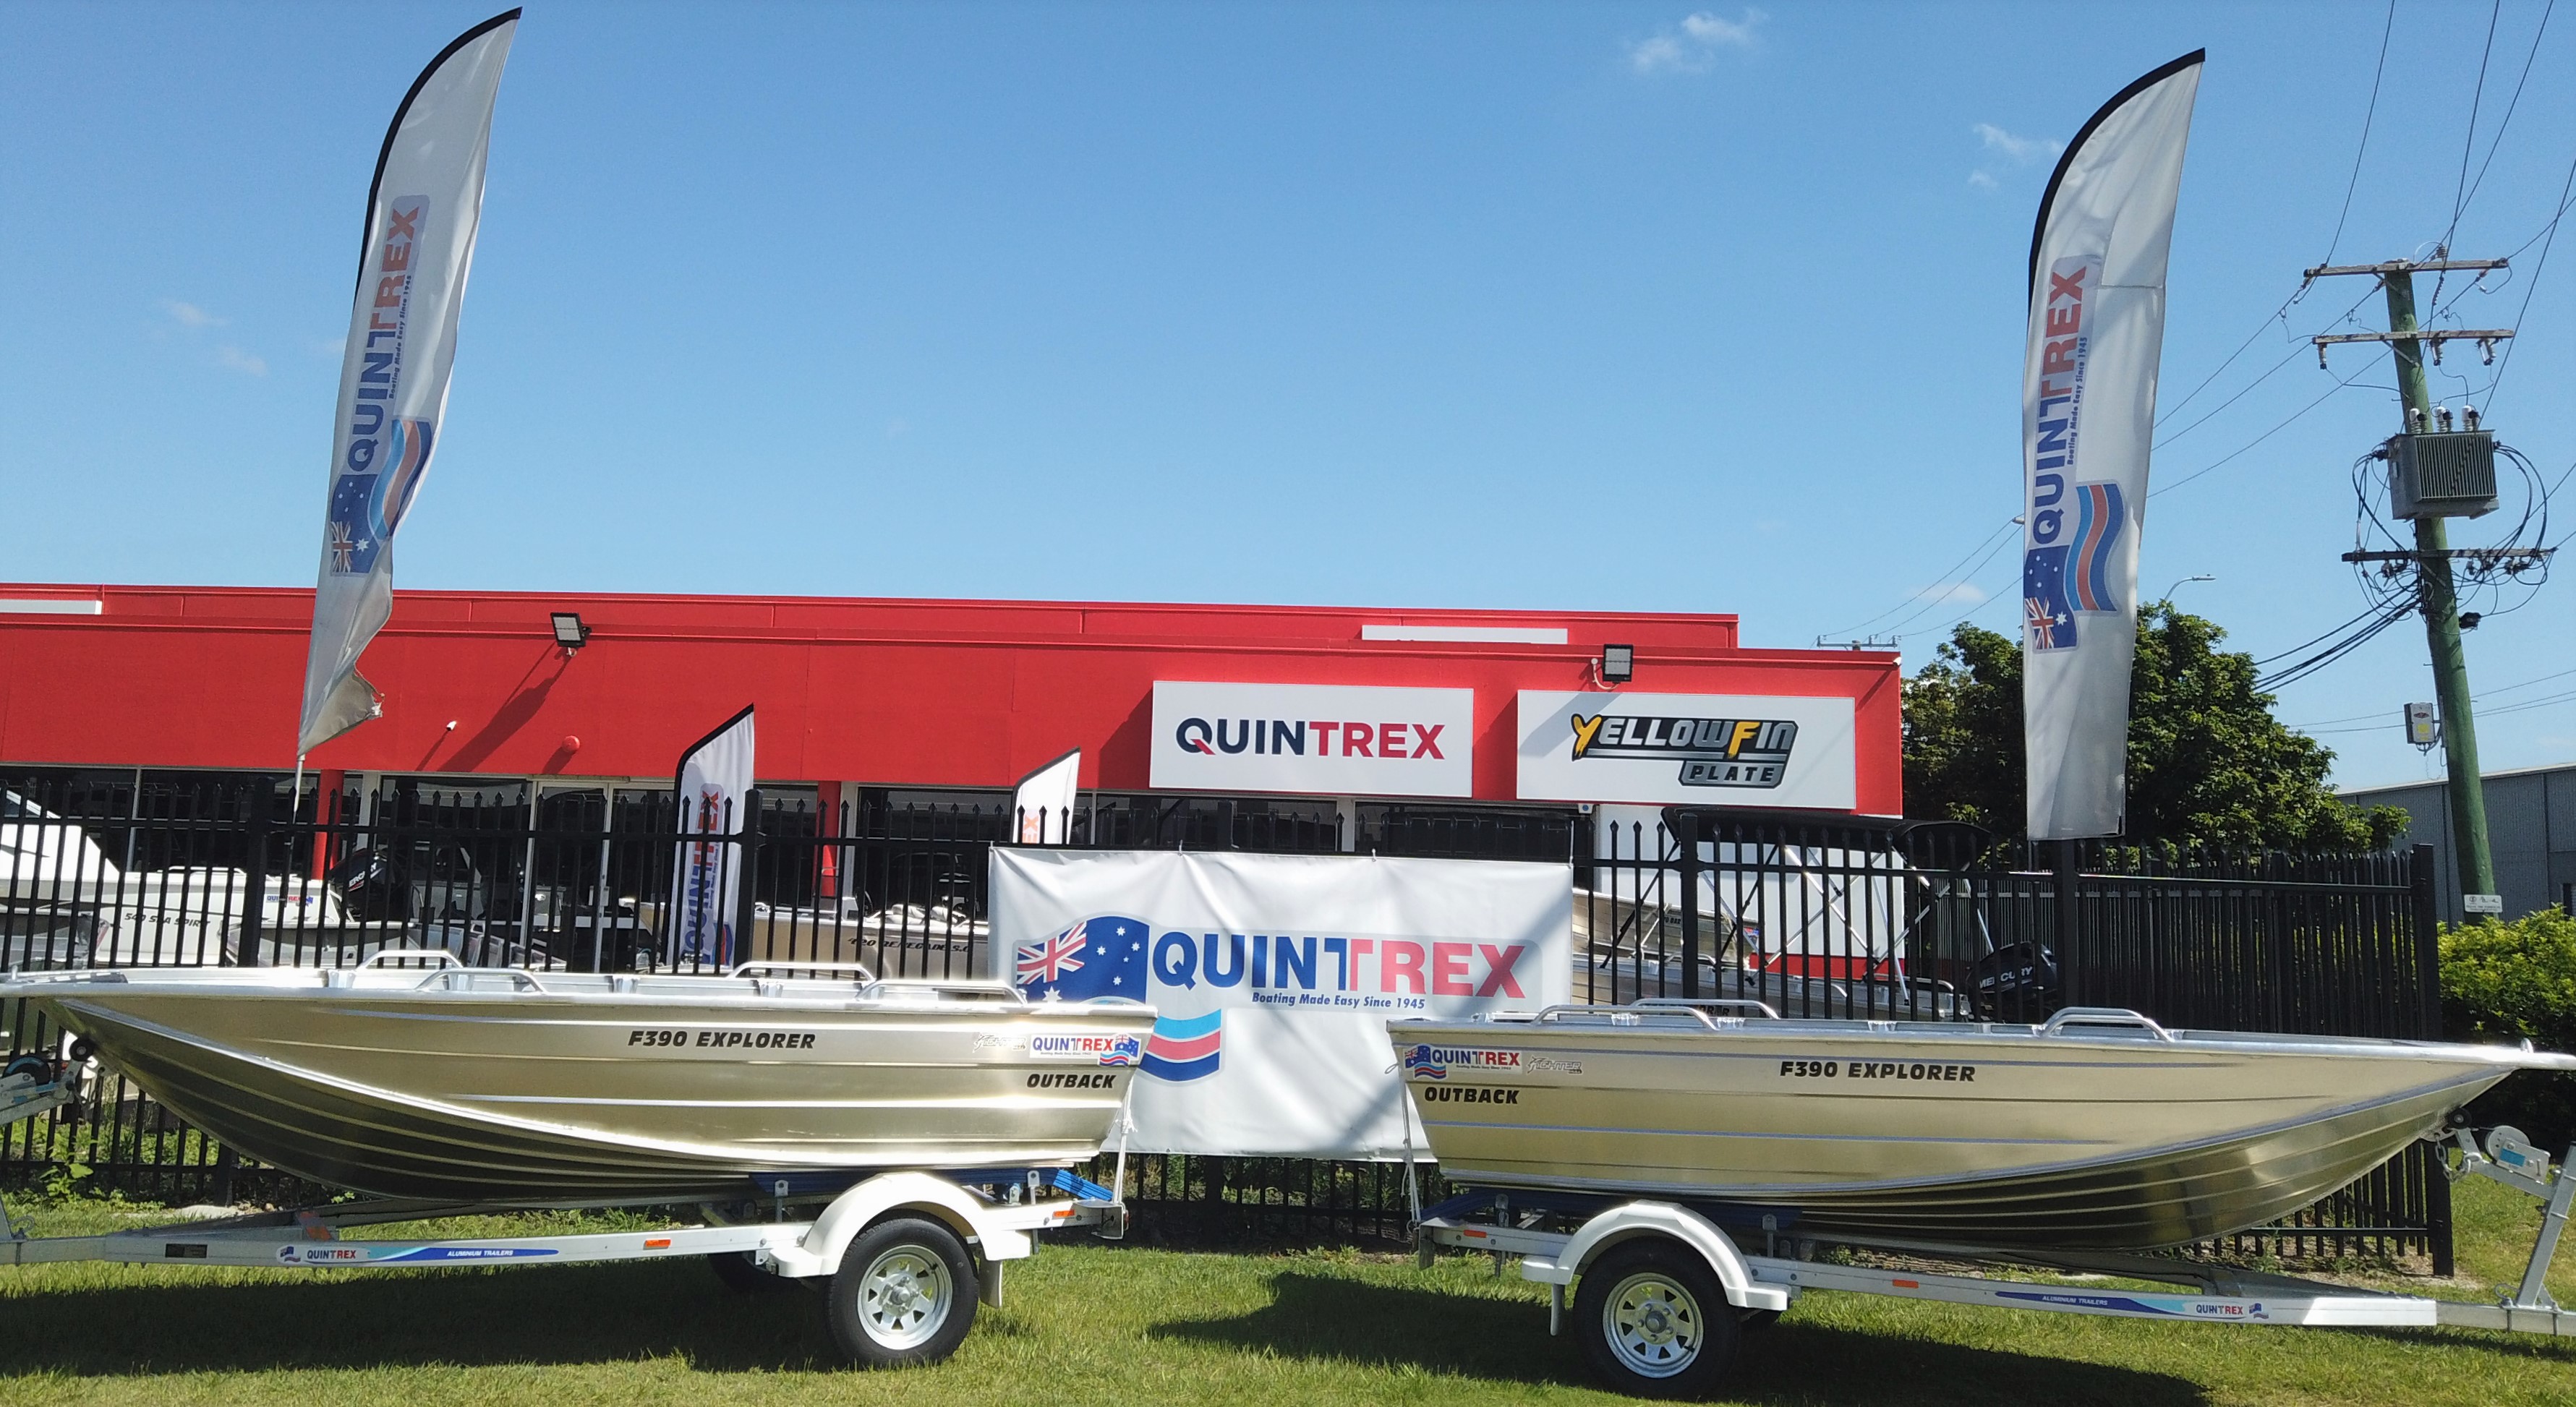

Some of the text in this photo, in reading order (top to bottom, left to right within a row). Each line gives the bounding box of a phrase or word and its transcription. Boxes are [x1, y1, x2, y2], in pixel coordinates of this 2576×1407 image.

[403, 275, 412, 295] 1945
[399, 298, 408, 319] Since
[347, 205, 419, 472] QUINTREX
[397, 321, 406, 340] Easy
[388, 367, 401, 399] Boating
[2032, 265, 2087, 545] QUINTREX
[2067, 337, 2088, 466] Boating Made Easy Since 1945
[1176, 717, 1446, 760] QUINTREX
[1688, 764, 1775, 782] PLATE
[1153, 931, 1525, 998] QUINTREX
[1252, 992, 1425, 1009] Boating Made Easy Since 1945
[628, 1030, 816, 1049] F390 EXPLORER
[1033, 1037, 1114, 1051] QUINTREX
[1432, 1049, 1520, 1066] QUINTREX
[1027, 1074, 1117, 1088] OUTBACK
[1780, 1061, 1975, 1082] F390 EXPLORER
[1425, 1087, 1519, 1104] OUTBACK
[307, 1249, 357, 1260] QUINTREX
[2196, 1304, 2243, 1315] QUINTREX
